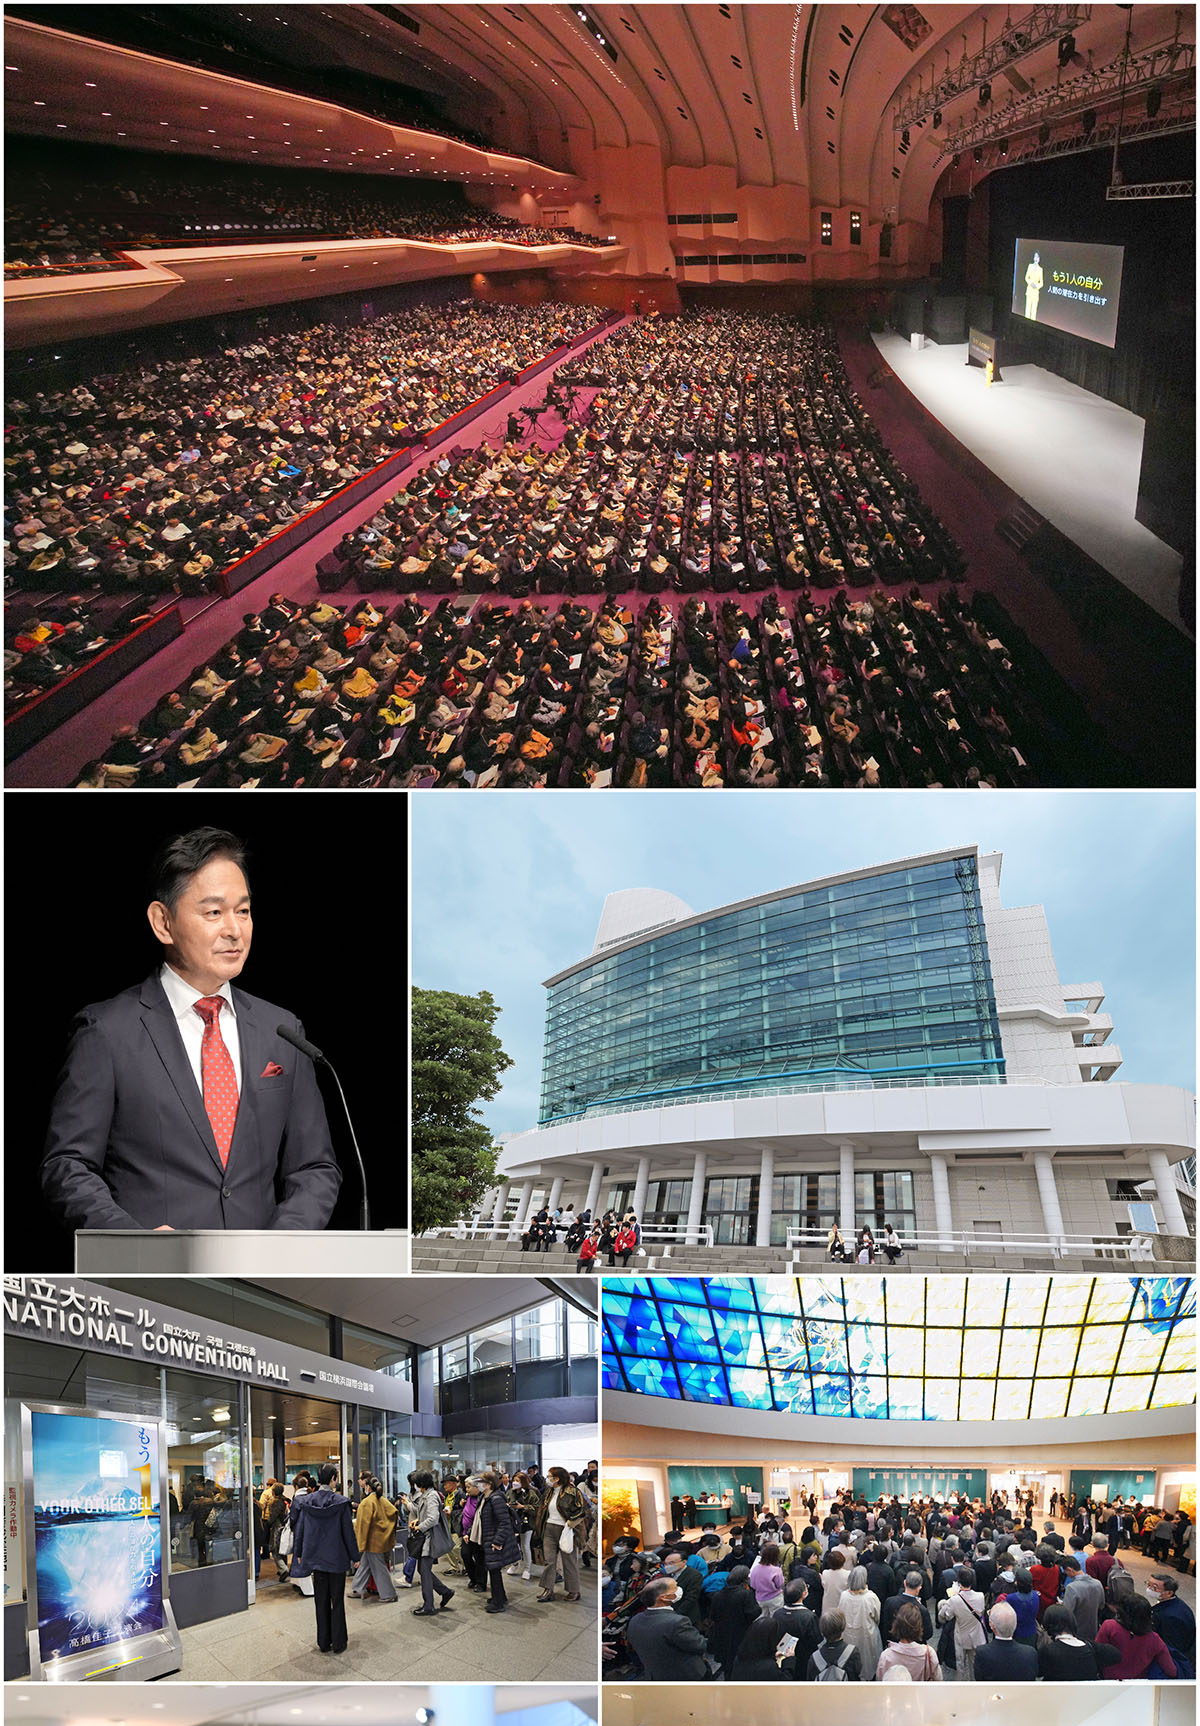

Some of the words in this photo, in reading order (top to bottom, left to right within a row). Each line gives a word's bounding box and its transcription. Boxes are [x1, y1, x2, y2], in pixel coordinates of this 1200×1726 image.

[1053, 270, 1103, 290] もう1人の自分
[4, 1297, 133, 1347] NATIONAL
[142, 1331, 252, 1373] CONVENTION
[258, 1361, 289, 1382] HALL
[319, 1370, 375, 1393] 国立横浜国際会議場
[40, 1498, 81, 1515] YOUR
[85, 1496, 126, 1514] OTHER
[129, 1496, 158, 1511] SELF
